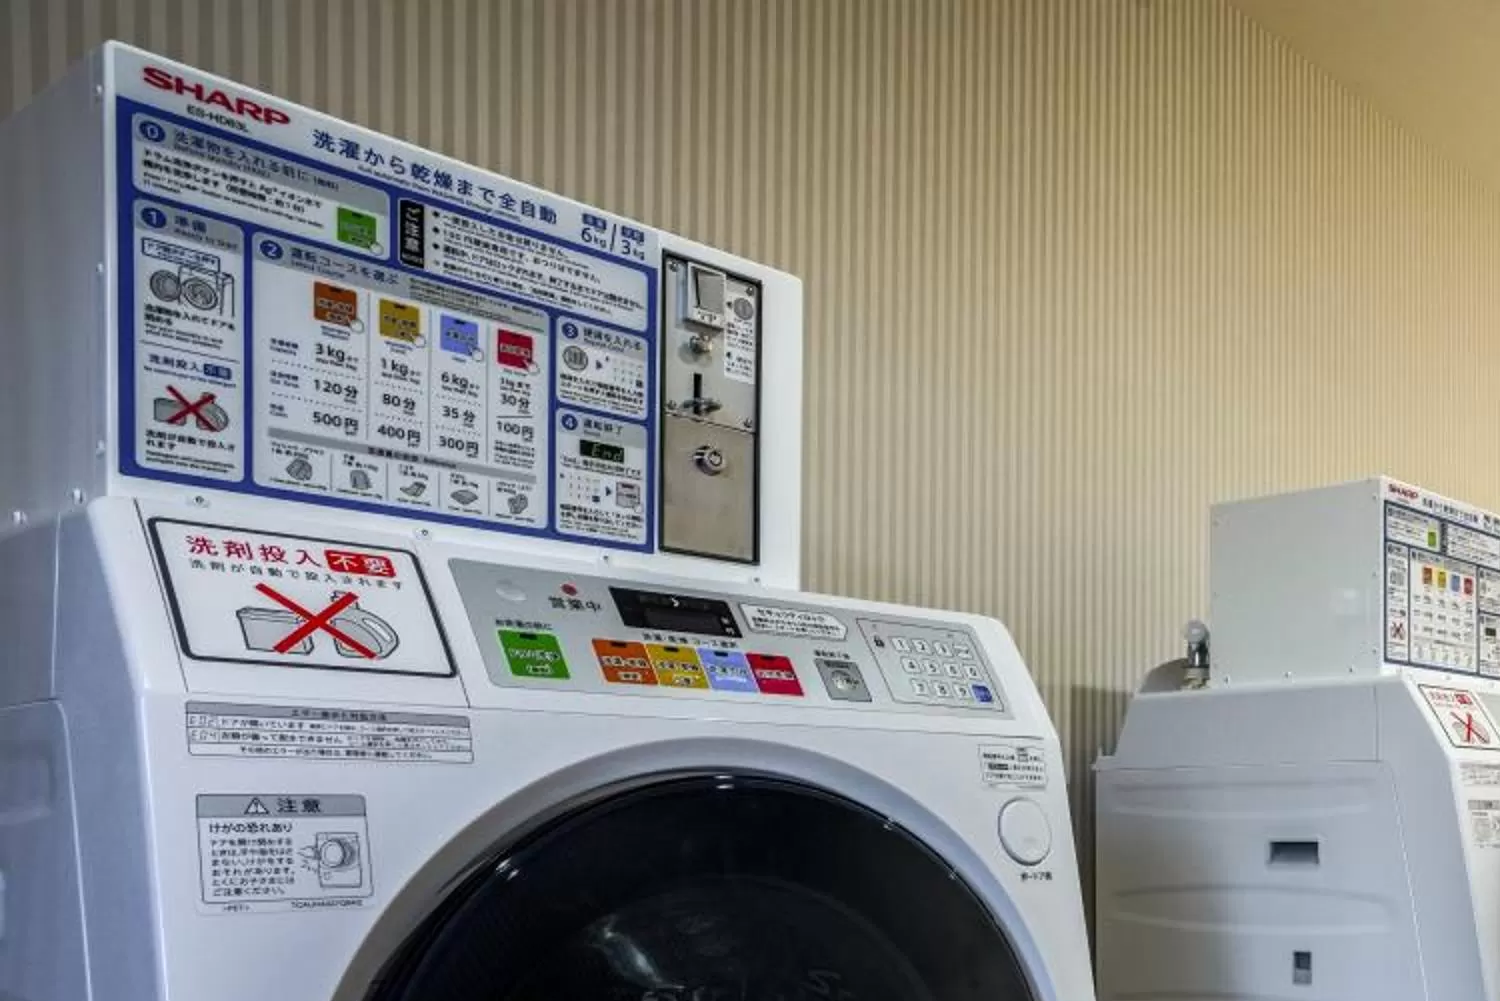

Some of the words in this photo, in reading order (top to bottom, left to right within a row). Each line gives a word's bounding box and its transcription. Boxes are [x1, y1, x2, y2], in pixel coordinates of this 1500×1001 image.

[142, 65, 290, 126] SHARP
[312, 128, 558, 226] 洗濯から乾燥まで全自動
[313, 377, 358, 398] 120分
[382, 393, 416, 411] 80分
[313, 410, 359, 431] 500円
[442, 405, 476, 423] 35分
[377, 424, 421, 443] 400円
[497, 420, 534, 438] 100円
[439, 436, 479, 456] 300円
[186, 535, 321, 568] 洗剤投入
[331, 554, 391, 575] 不要
[189, 558, 403, 590] 洗剤が自動で投入されます
[276, 797, 322, 814] 注意
